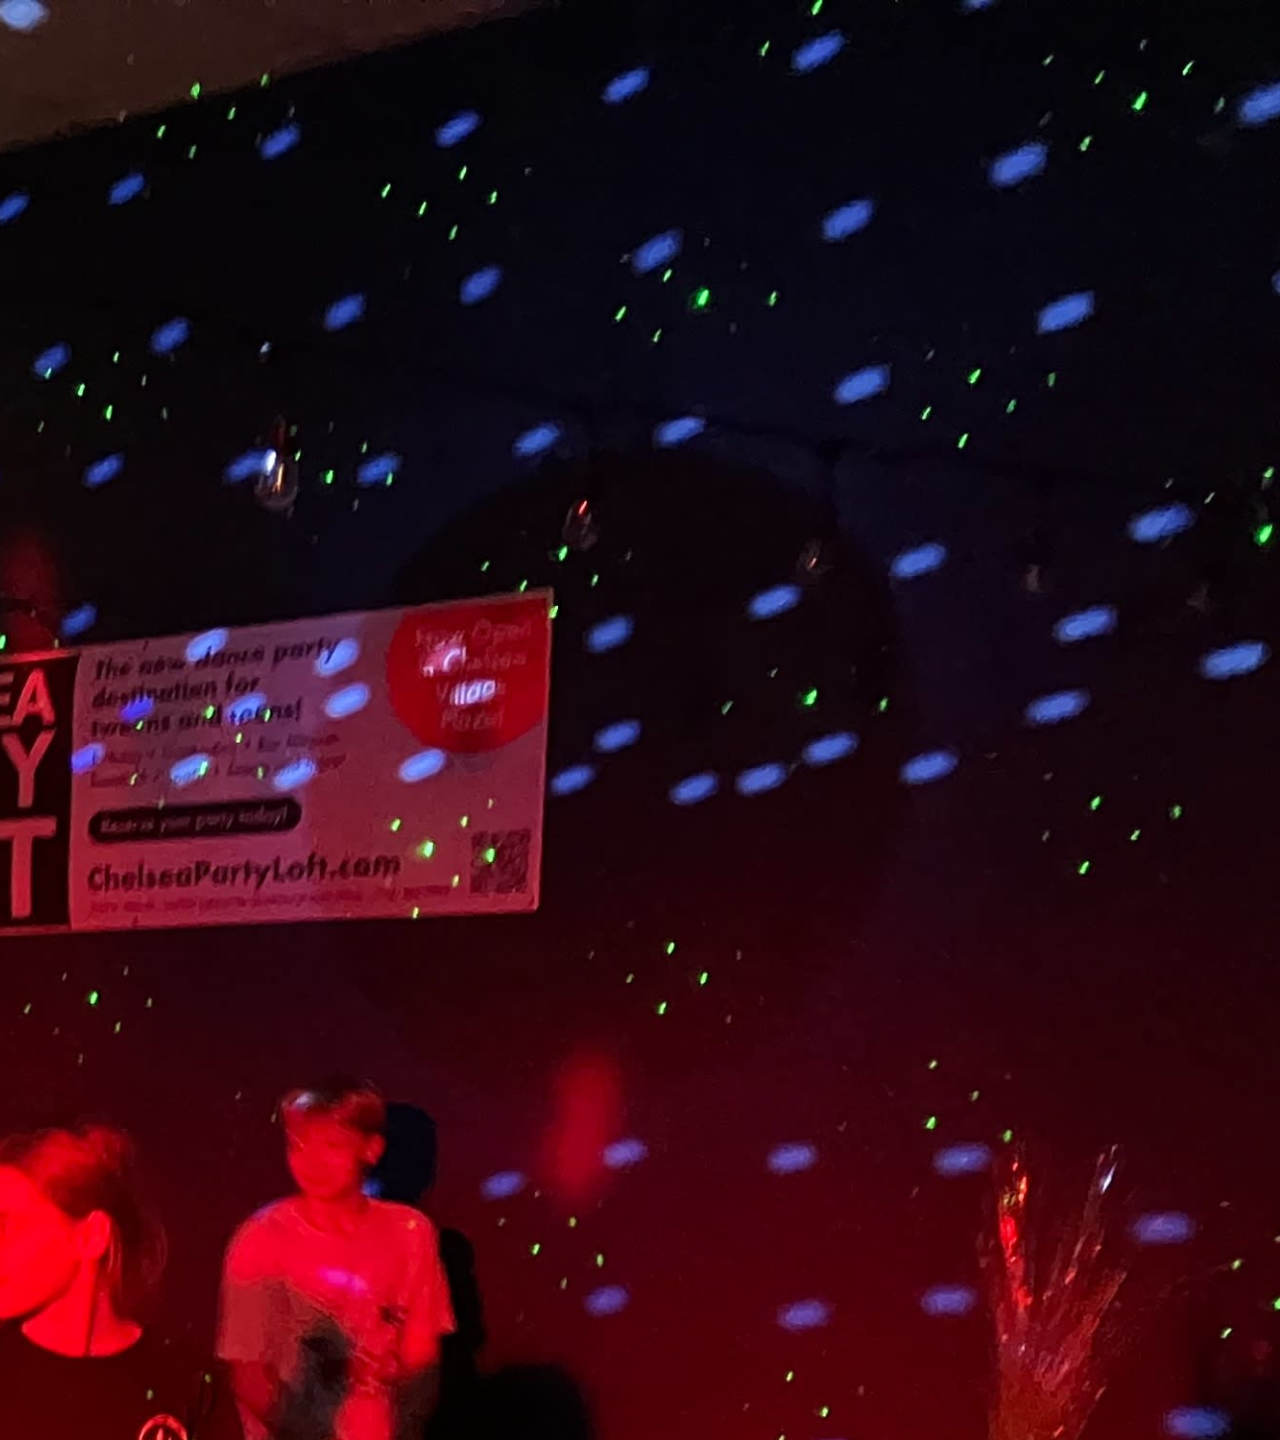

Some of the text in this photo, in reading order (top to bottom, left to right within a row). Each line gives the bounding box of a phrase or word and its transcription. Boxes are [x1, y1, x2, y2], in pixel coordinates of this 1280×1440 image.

[96, 659, 132, 679] The
[138, 657, 186, 674] new
[272, 638, 341, 667] party
[93, 670, 261, 706] destination for
[88, 852, 401, 890] ChelseaPartyLoft.com
